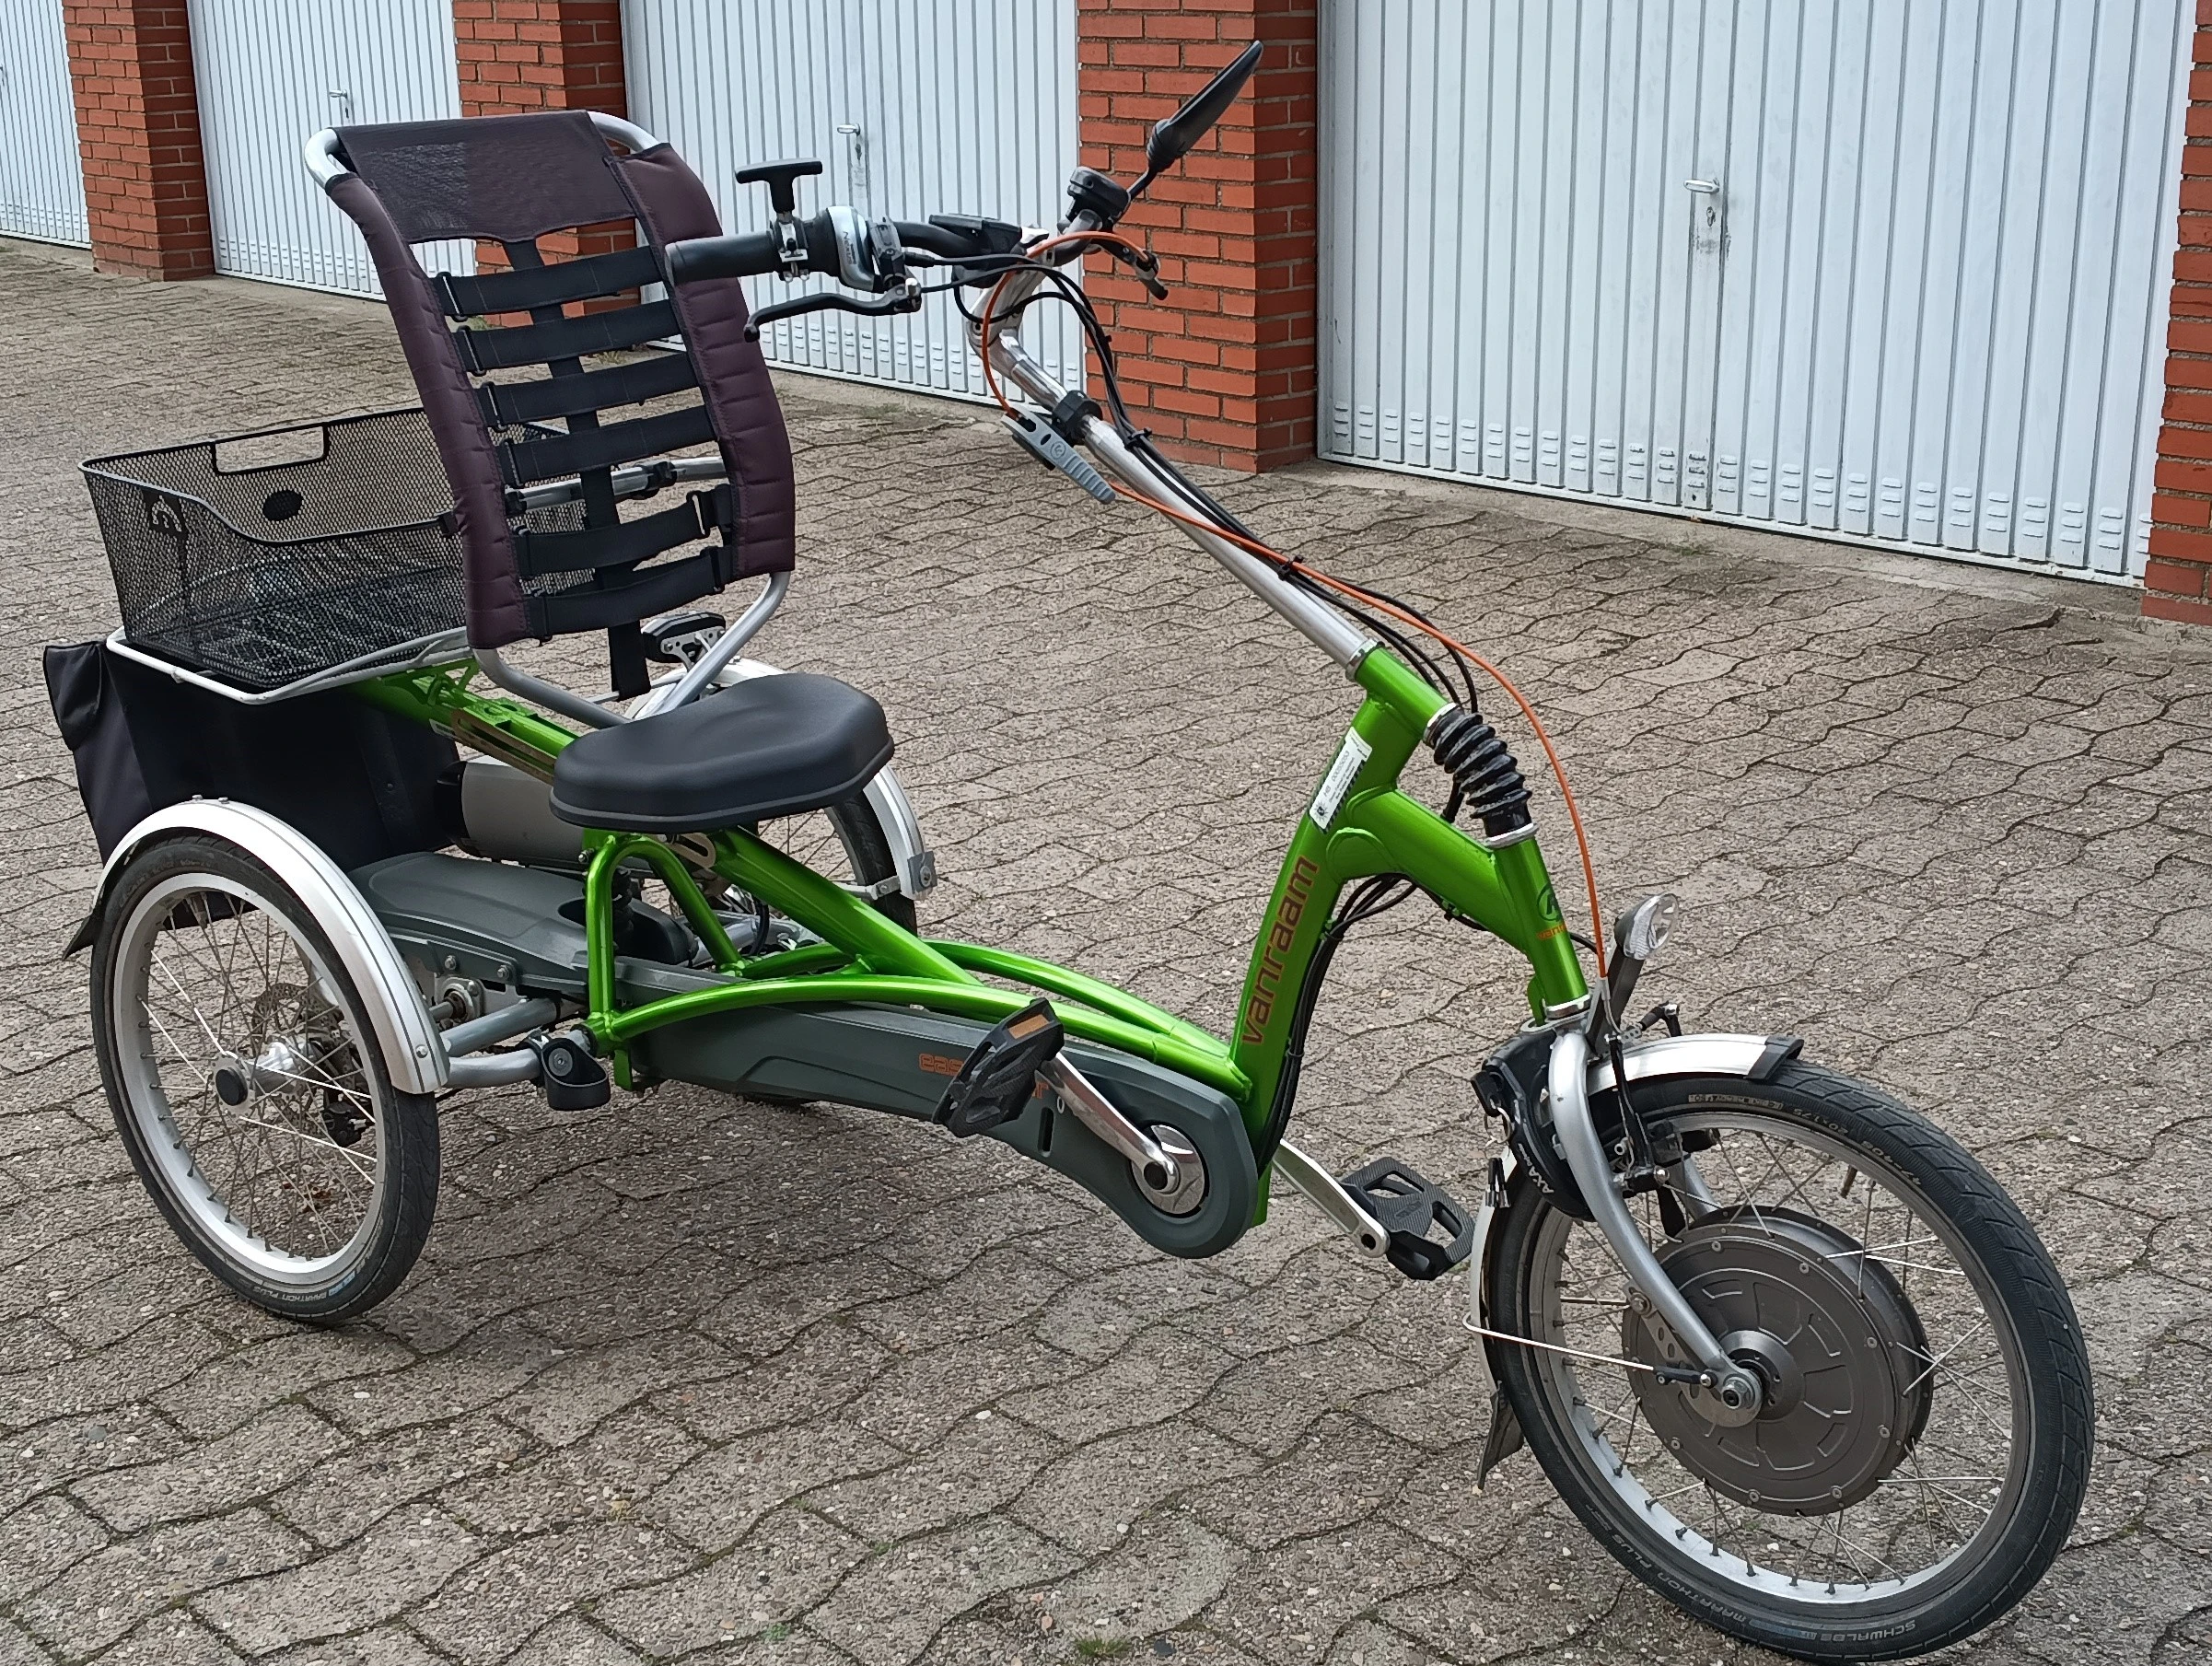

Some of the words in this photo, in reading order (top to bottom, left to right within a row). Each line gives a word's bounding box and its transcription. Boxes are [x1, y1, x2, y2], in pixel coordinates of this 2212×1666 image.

[1242, 855, 1320, 1044] vanraam
[919, 1054, 964, 1076] eas
[1529, 1166, 1554, 1193] AXA
[1612, 1534, 1652, 1569] PLUS
[1657, 1571, 1747, 1623] MARATHON
[1820, 1619, 1916, 1642] SCHWALBE
